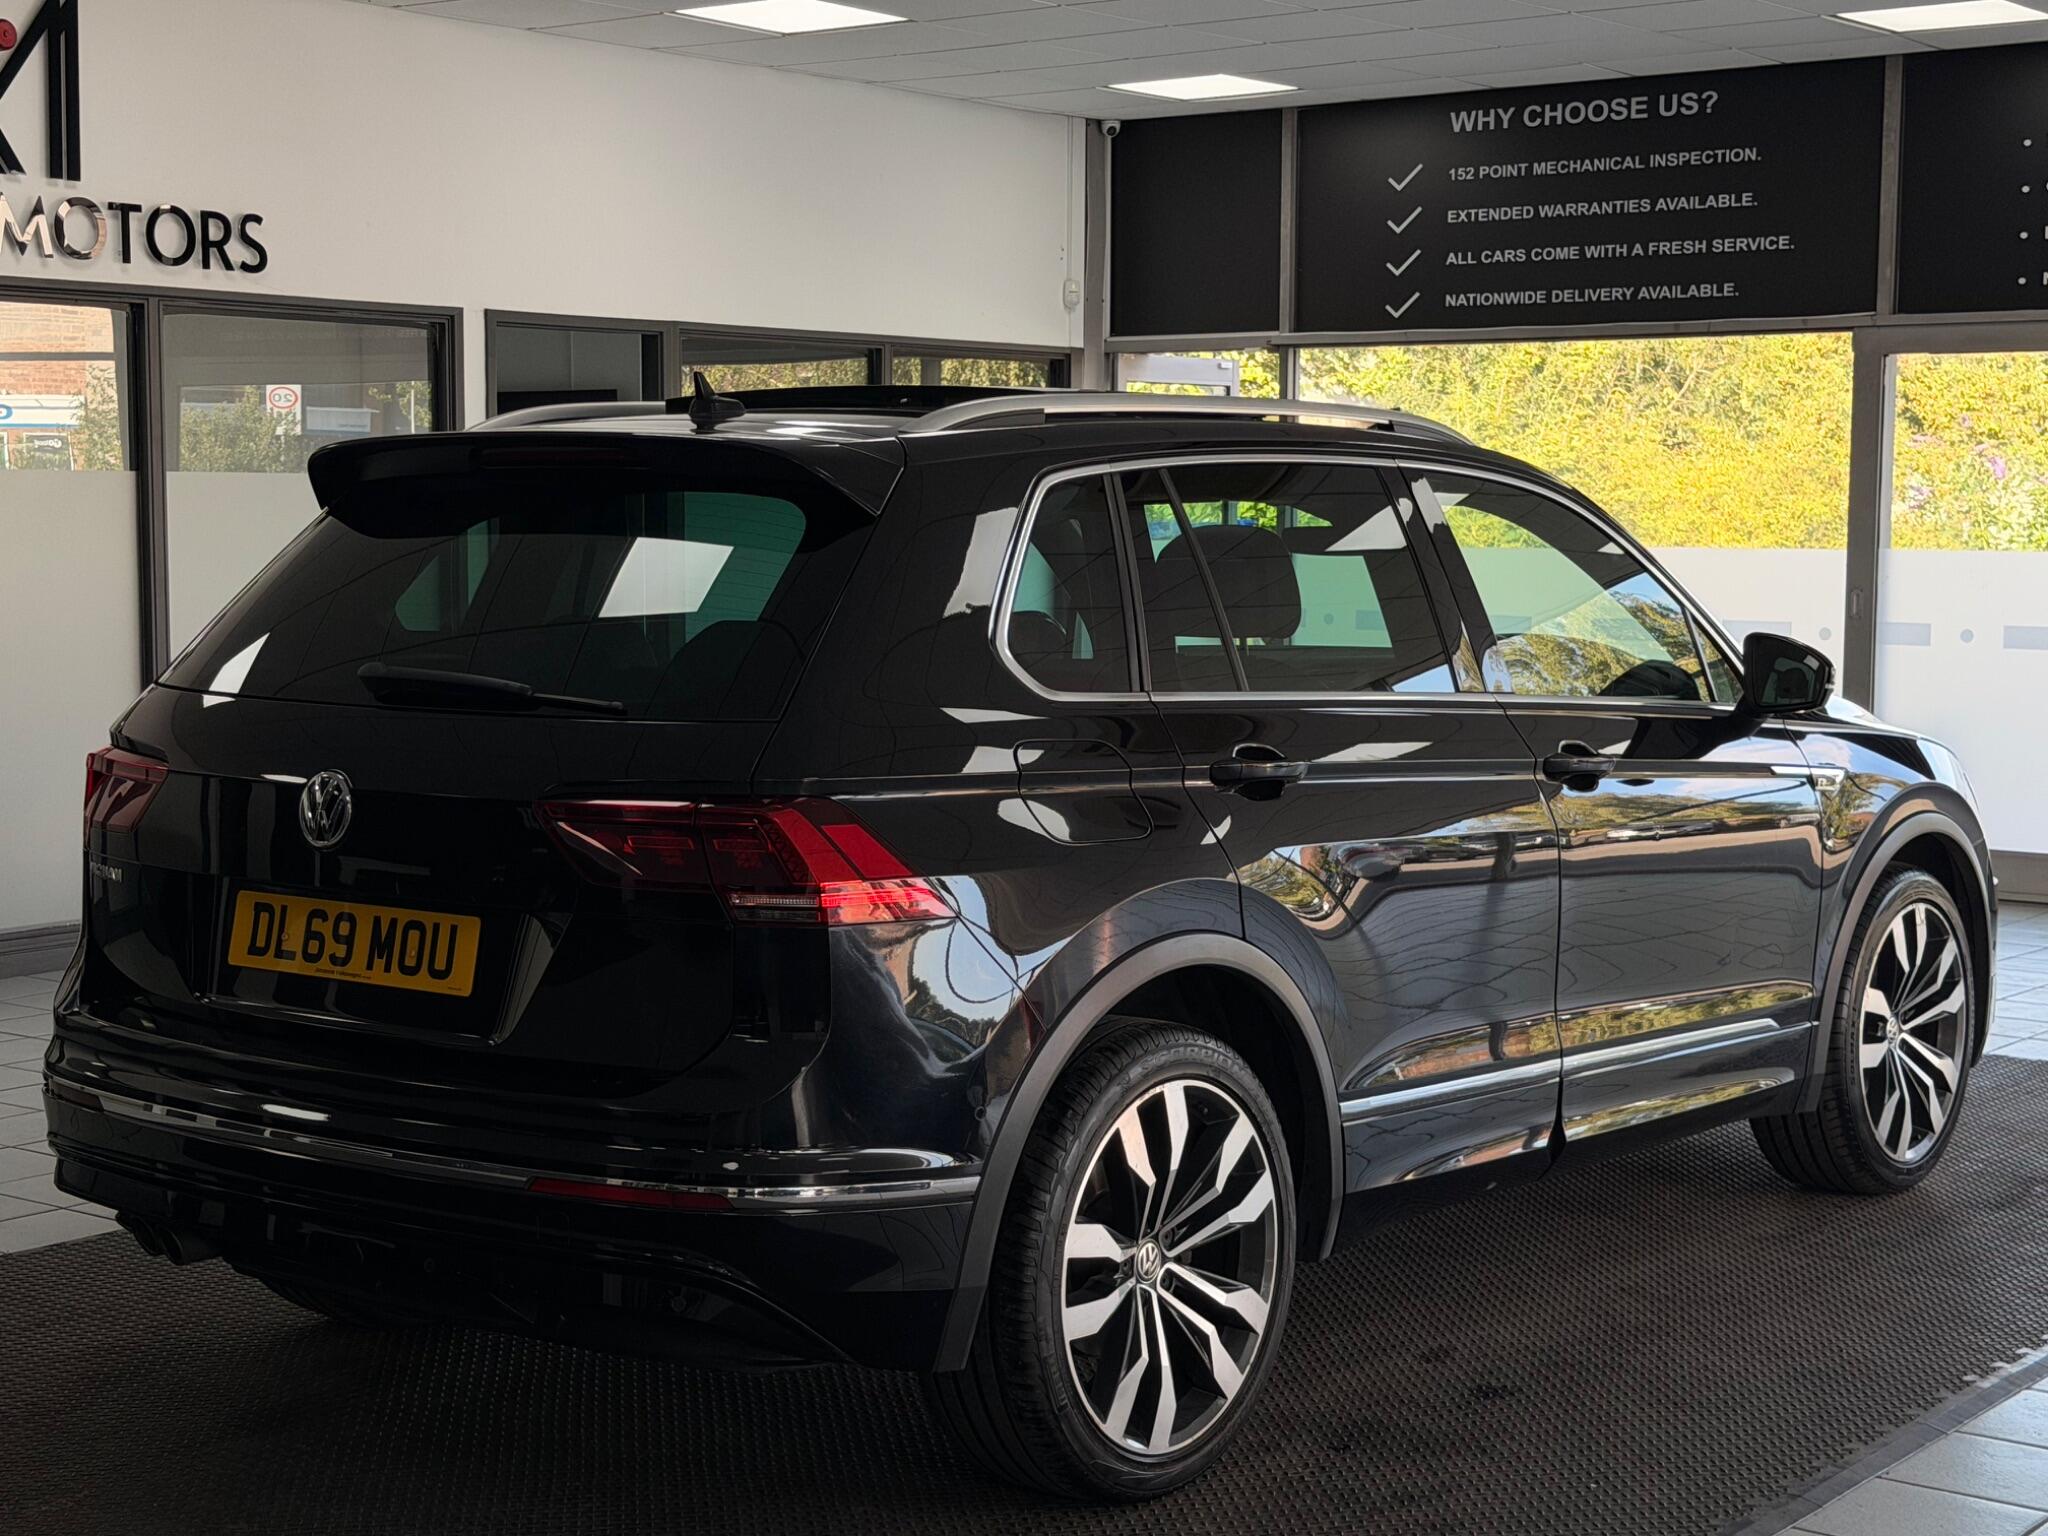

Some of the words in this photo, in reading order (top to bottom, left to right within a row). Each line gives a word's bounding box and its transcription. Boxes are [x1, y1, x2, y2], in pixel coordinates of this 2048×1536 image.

[1450, 107, 1516, 133] WHY
[1523, 99, 1649, 127] CHOOSE
[1659, 91, 1718, 117] US?
[1449, 167, 1475, 181] 152
[1479, 163, 1529, 179] POINT
[1533, 155, 1645, 176] MECHANICAL
[1650, 147, 1762, 168] INSPECTION.
[1447, 205, 1534, 223] EXTENDED
[1538, 199, 1651, 218] WARRANTIES
[1655, 192, 1758, 212] AVAILABLE.
[0, 191, 268, 273] MOTORS
[1446, 251, 1477, 265] ALL
[1481, 249, 1527, 264] CARS
[1531, 246, 1580, 262] COME
[1585, 243, 1627, 259] WITH
[1631, 243, 1644, 257] A
[1649, 240, 1707, 255] FRESH
[1712, 236, 1795, 253] SERVICE.
[1445, 290, 1547, 307] NATIONWIDE
[1552, 287, 1635, 303] DELIVERY
[1638, 282, 1739, 300] AVAILABLE.
[248, 901, 357, 967] DL69
[366, 915, 458, 980] MOU
